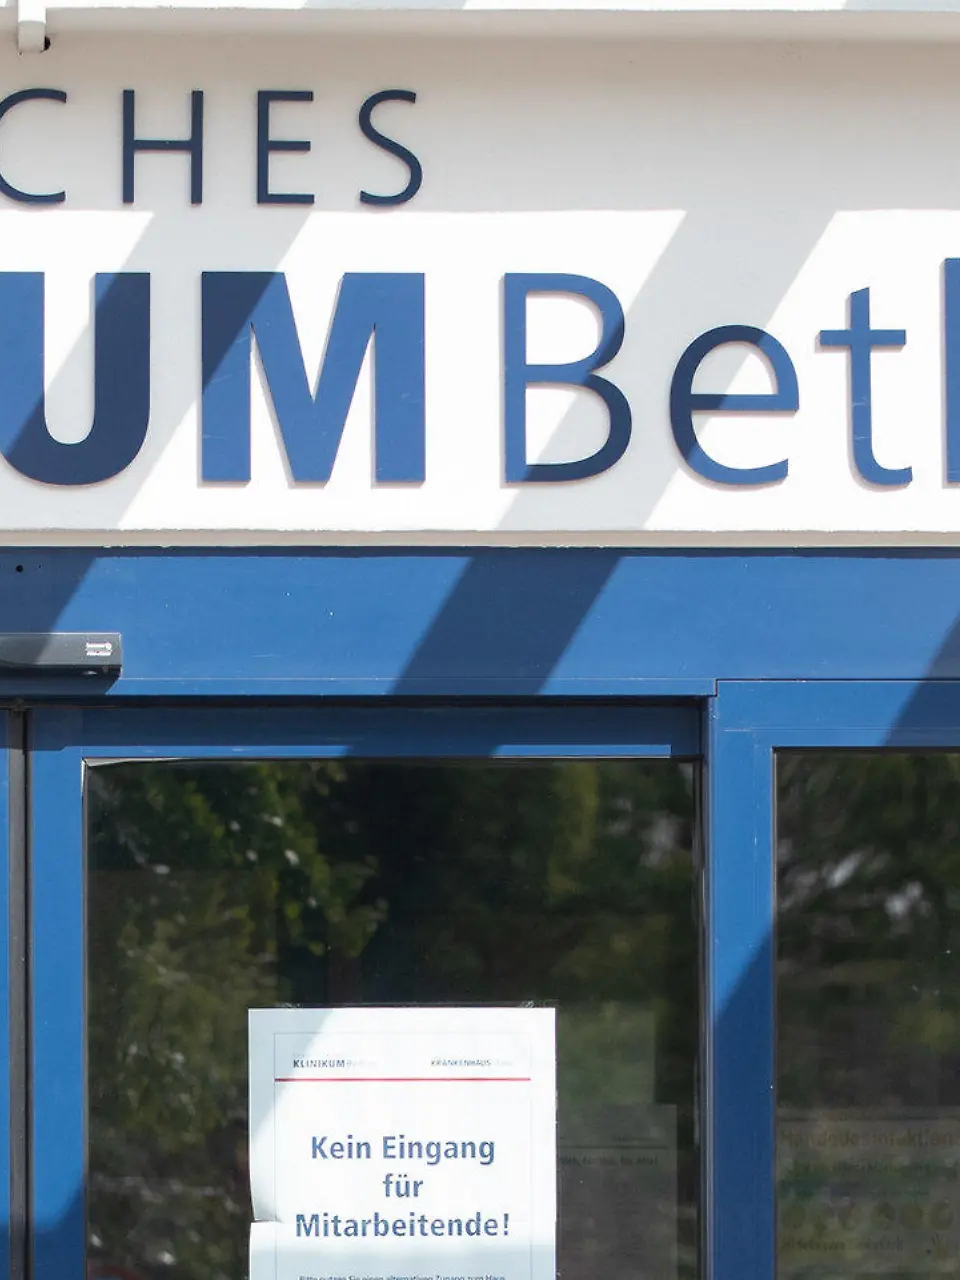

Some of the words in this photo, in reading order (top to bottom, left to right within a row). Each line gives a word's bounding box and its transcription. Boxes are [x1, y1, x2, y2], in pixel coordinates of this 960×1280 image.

[501, 258, 960, 486] Bet
[311, 1134, 372, 1160] Kein
[382, 1134, 496, 1166] Eingang
[383, 1173, 424, 1198] für
[296, 1212, 510, 1238] Mitarbeitende!
